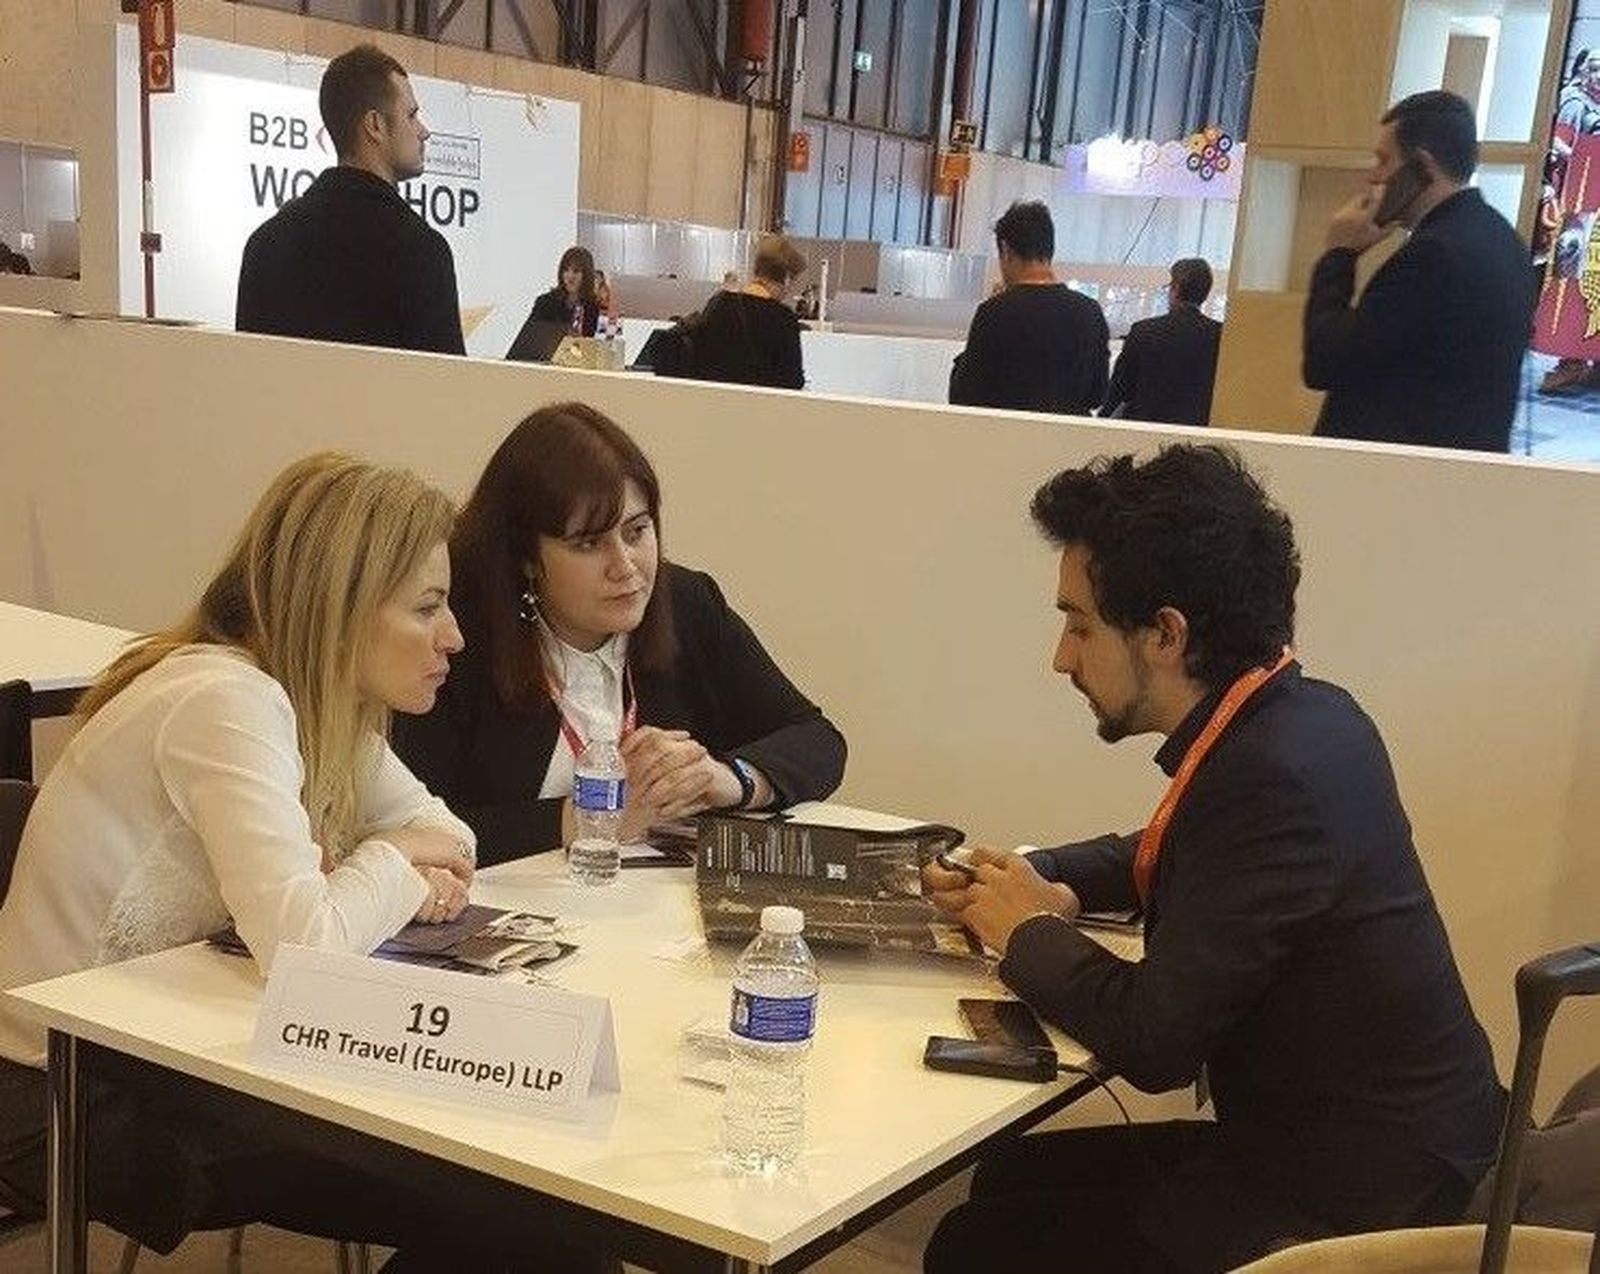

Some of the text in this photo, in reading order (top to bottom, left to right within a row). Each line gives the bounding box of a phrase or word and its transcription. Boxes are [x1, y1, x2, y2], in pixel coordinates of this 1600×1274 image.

[249, 111, 308, 149] B2B
[250, 163, 480, 227] WOHOP
[405, 1002, 450, 1037] 19
[281, 1023, 563, 1092] CHR Travel (Europe) LLP
